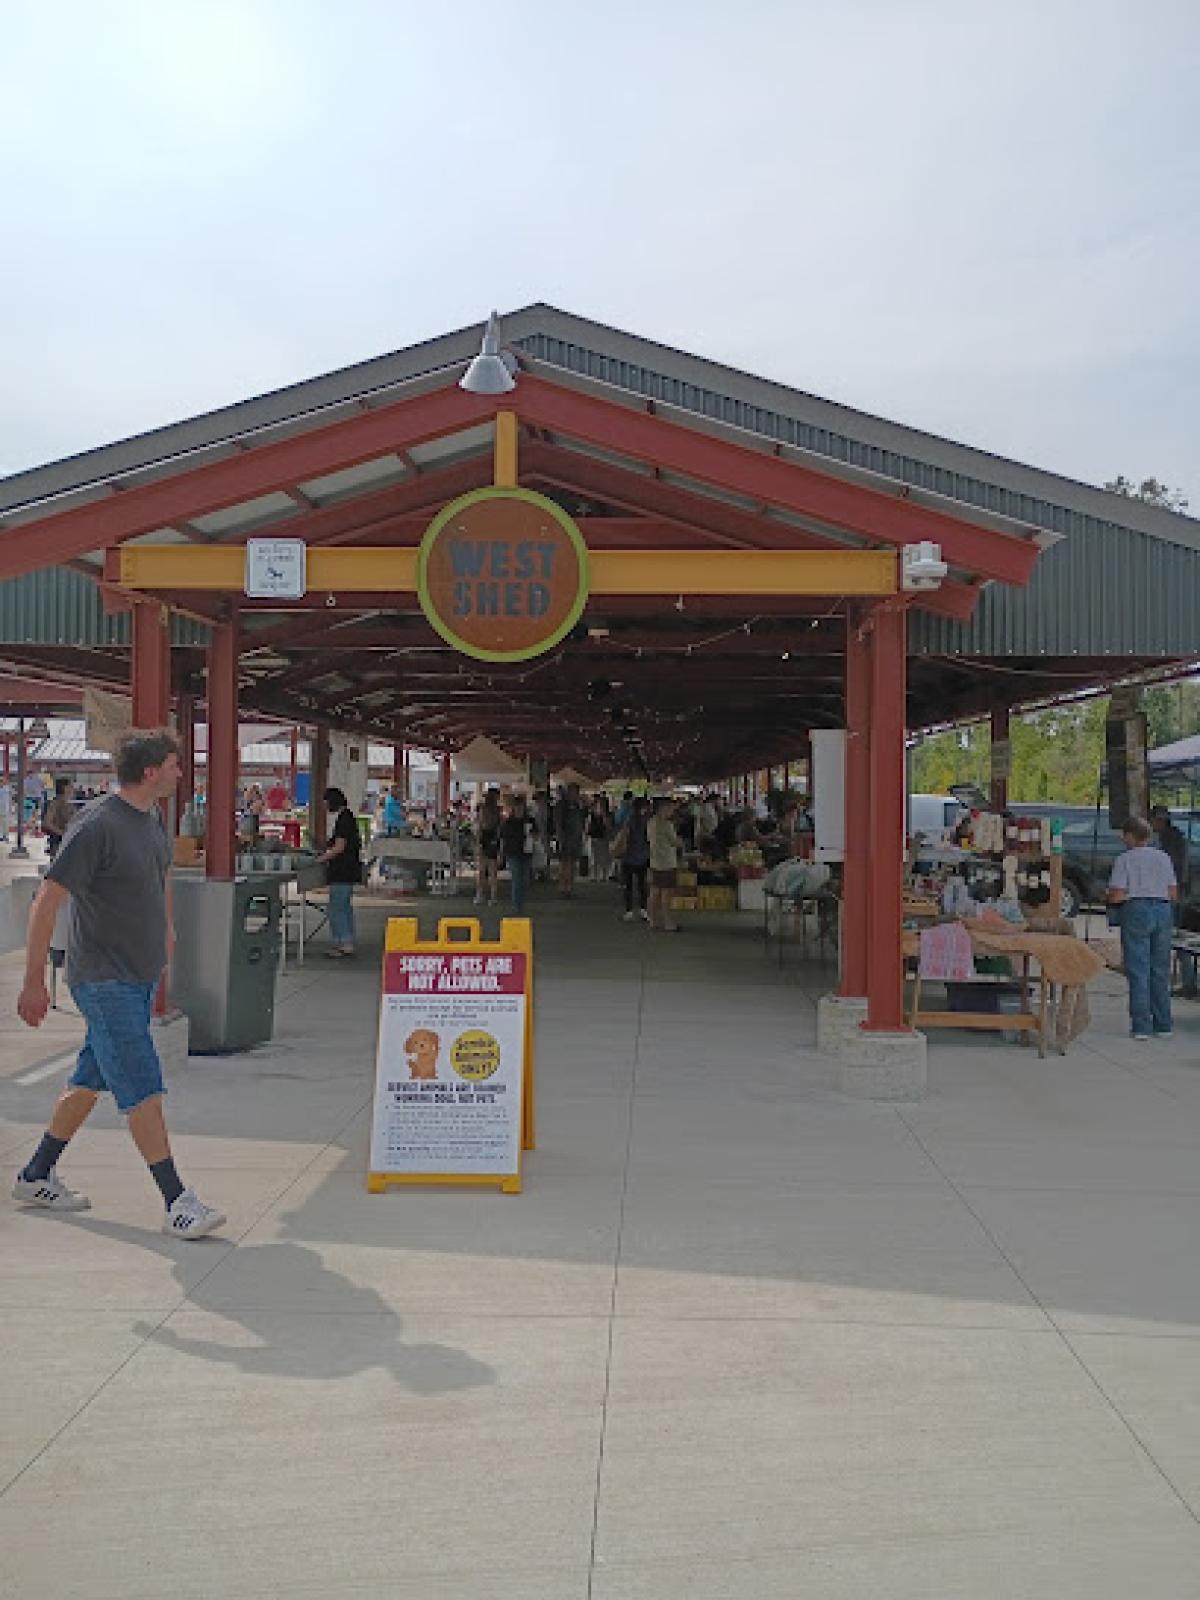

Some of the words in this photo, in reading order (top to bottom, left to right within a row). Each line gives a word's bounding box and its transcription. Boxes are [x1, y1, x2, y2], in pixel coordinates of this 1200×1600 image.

[450, 540, 559, 578] WEST
[453, 581, 550, 617] SHED
[400, 956, 447, 974] SORRY,
[452, 956, 482, 974] PETS
[485, 956, 512, 974] ARE
[409, 973, 434, 991] NOT
[437, 973, 501, 991] ALLOWED.
